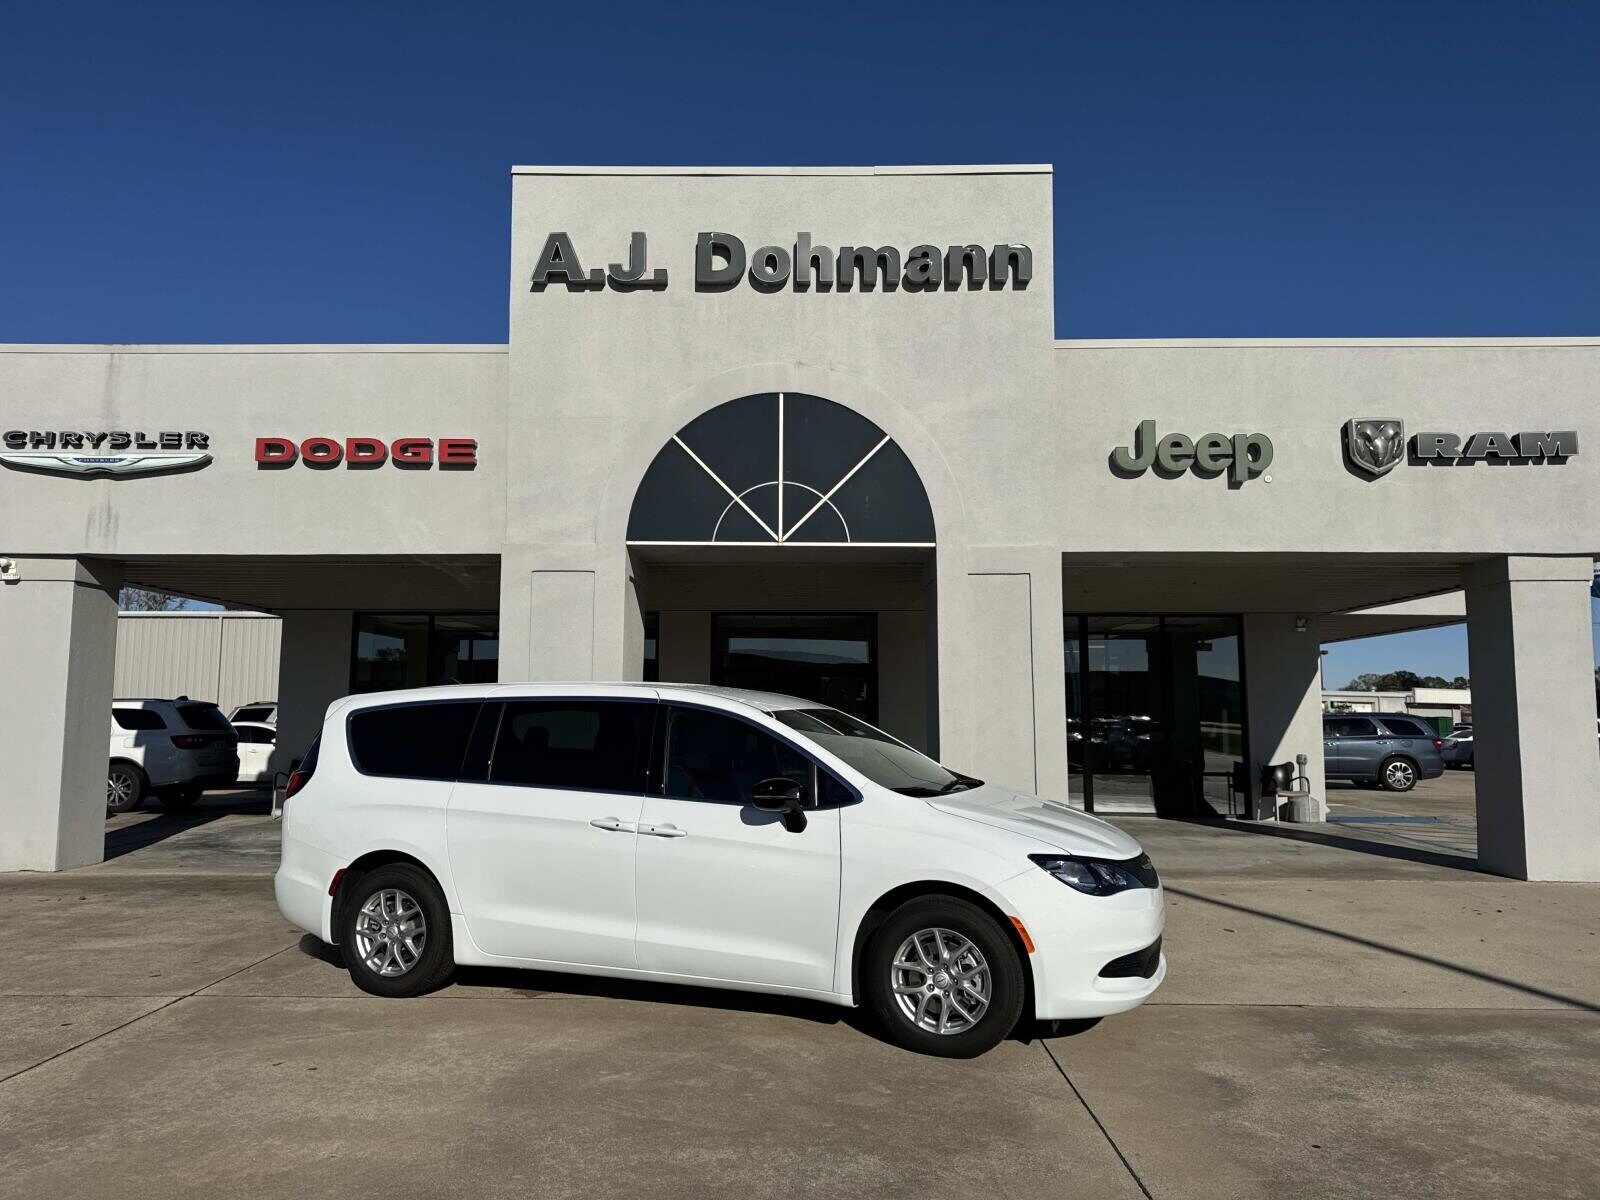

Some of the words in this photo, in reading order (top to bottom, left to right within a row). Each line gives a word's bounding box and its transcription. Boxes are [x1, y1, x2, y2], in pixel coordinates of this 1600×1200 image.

[530, 231, 669, 292] A.J.
[695, 231, 1034, 292] Dohmann
[2, 430, 210, 450] CHRYSLER
[255, 437, 477, 471] DODGE
[1109, 419, 1274, 489] Jeep
[1408, 430, 1579, 466] RAM
